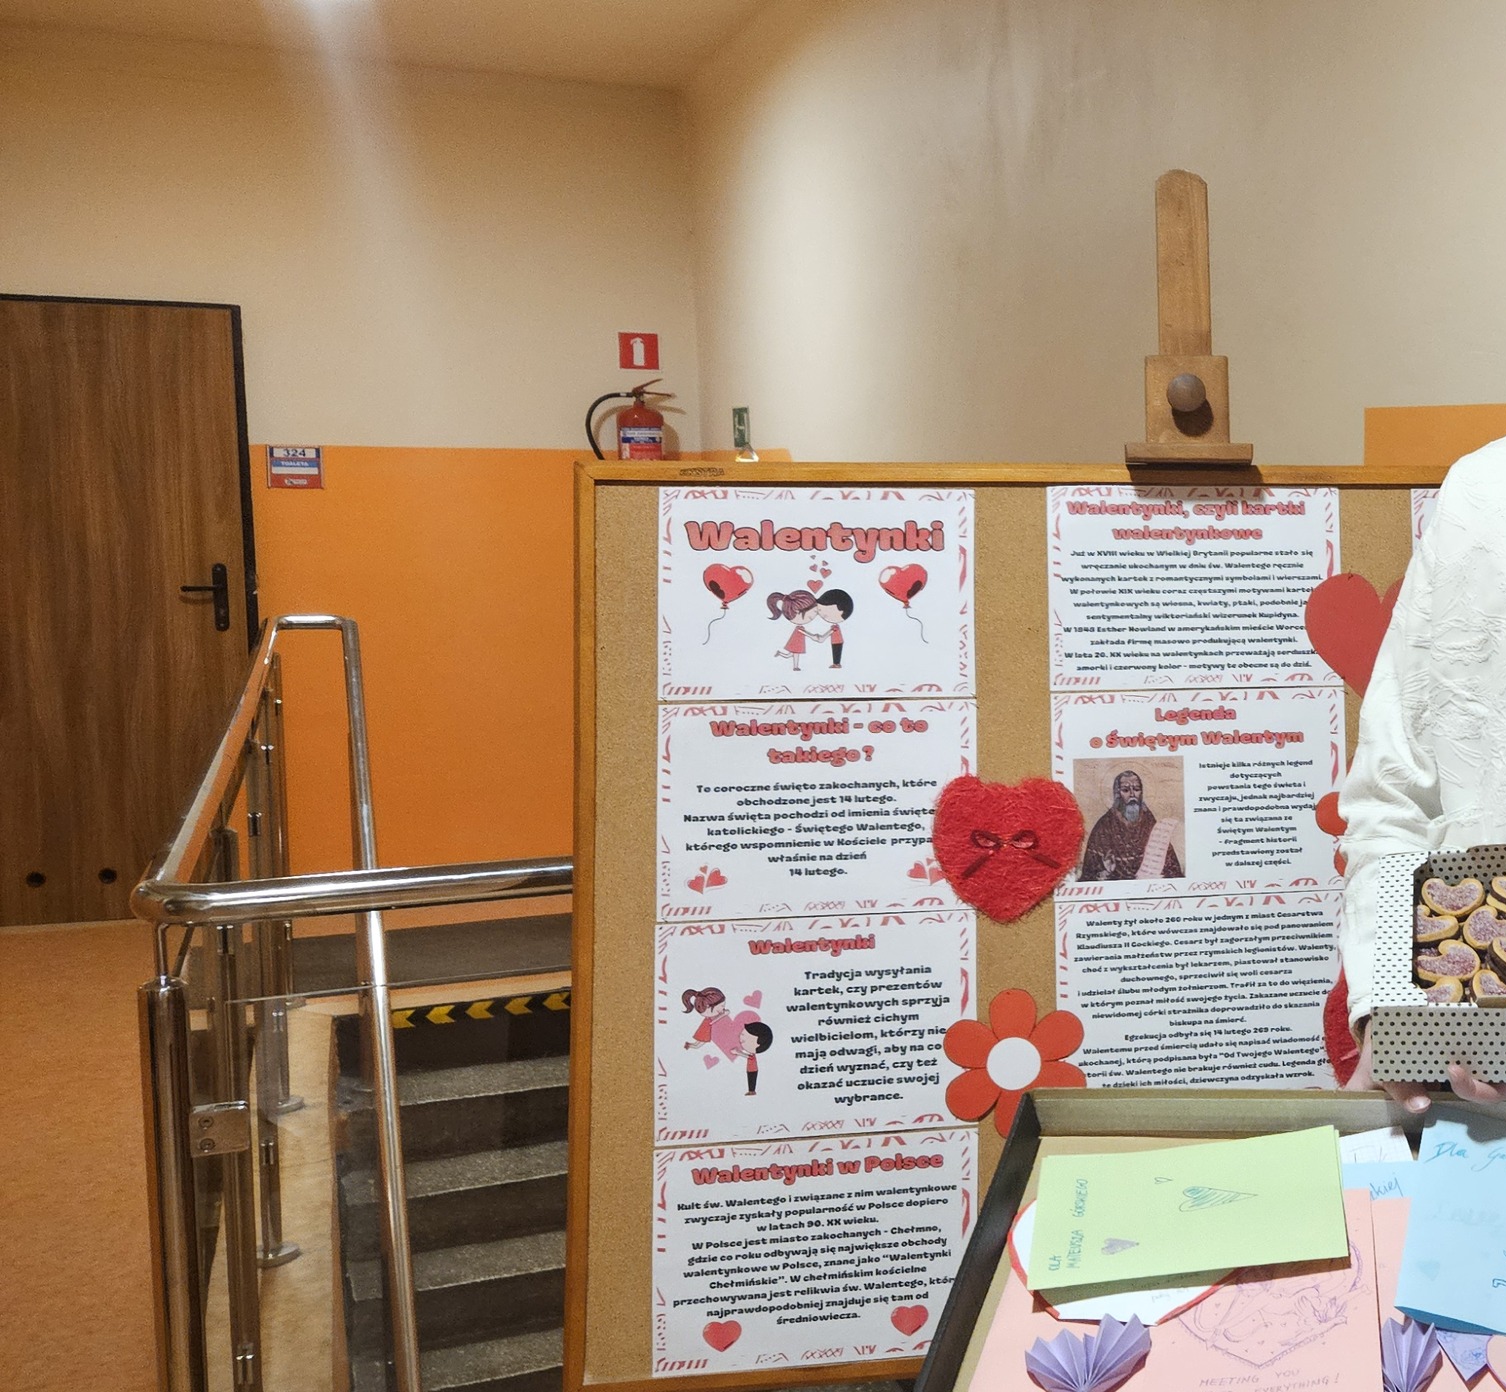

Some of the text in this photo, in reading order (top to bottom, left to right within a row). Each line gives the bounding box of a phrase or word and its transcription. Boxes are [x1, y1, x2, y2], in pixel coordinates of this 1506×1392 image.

[283, 449, 306, 457] 324
[1067, 500, 1305, 520] Walentynki, czyli kartki
[683, 519, 944, 563] Walentynki
[1112, 525, 1262, 545] walentynkowe
[1155, 705, 1236, 725] Legenda
[709, 717, 849, 741] Walentynki
[868, 720, 896, 733] co
[899, 717, 927, 733] to
[1089, 729, 1304, 751] o Świętym Walentym
[696, 778, 936, 793] To coroczne święto zakochanych, które
[736, 794, 896, 807] obchodzone jest 14 lutego.
[683, 805, 937, 822] Nazwa święta pochodzi od imienia święte
[707, 826, 784, 836] katolickiego
[795, 823, 853, 834] Świętego
[855, 822, 924, 832] Walentego,
[685, 841, 738, 852] którego
[739, 838, 821, 850] wspomnienie
[837, 836, 886, 845] Kościele
[891, 834, 935, 847] przypa
[767, 853, 816, 862] właśnie
[835, 850, 866, 860] dzień
[789, 867, 847, 877] 14 lutego.
[747, 933, 875, 956] Walentynki
[804, 965, 931, 981] Tradycja wysyłania
[794, 979, 942, 996] kartek, czy prezentów
[786, 994, 949, 1012] walentynkowych sprzyja
[817, 1013, 919, 1026] również cichym
[790, 1025, 946, 1043] wielbicielom, którzy nie
[795, 1048, 826, 1061] mają
[829, 1044, 881, 1057] odwagi,
[884, 1044, 907, 1055] aby
[926, 1041, 942, 1051] co
[799, 1057, 937, 1074] dzień wyznać, czy też
[797, 1073, 939, 1090] okazać uczucie swojej
[834, 1092, 903, 1106] wybrance.
[1425, 1141, 1469, 1163] Dla
[691, 1153, 943, 1185] Walentynki w Polsce
[677, 1202, 701, 1210] Kult
[703, 1200, 723, 1208] św.
[725, 1196, 786, 1207] Walentego
[788, 1194, 791, 1202] i
[793, 1193, 844, 1202] związane
[854, 1189, 873, 1197] nim
[875, 1184, 956, 1196] walentynkowe
[684, 1212, 736, 1225] zwyczaje
[738, 1209, 782, 1222] zyskały
[784, 1203, 853, 1217] popularność
[868, 1201, 904, 1209] Polsce
[905, 1197, 948, 1207] dopiero
[768, 1220, 804, 1231] latach
[807, 1219, 824, 1227] 90.
[826, 1218, 841, 1226] XX
[842, 1216, 878, 1225] wieku.
[691, 1242, 703, 1250] W
[705, 1240, 742, 1249] Polsce
[742, 1237, 767, 1249] jest
[769, 1234, 808, 1244] miasto
[810, 1228, 881, 1241] zakochanych
[890, 1225, 941, 1234] Chełmno,
[687, 1254, 717, 1266] gdzie
[735, 1251, 761, 1260] roku
[763, 1246, 818, 1259] odbywają
[820, 1245, 836, 1254] się
[837, 1241, 899, 1254] największe
[901, 1237, 947, 1247] obchody
[776, 1312, 860, 1324] średniowiecza.
[1199, 1369, 1299, 1387] MEETING YOU
